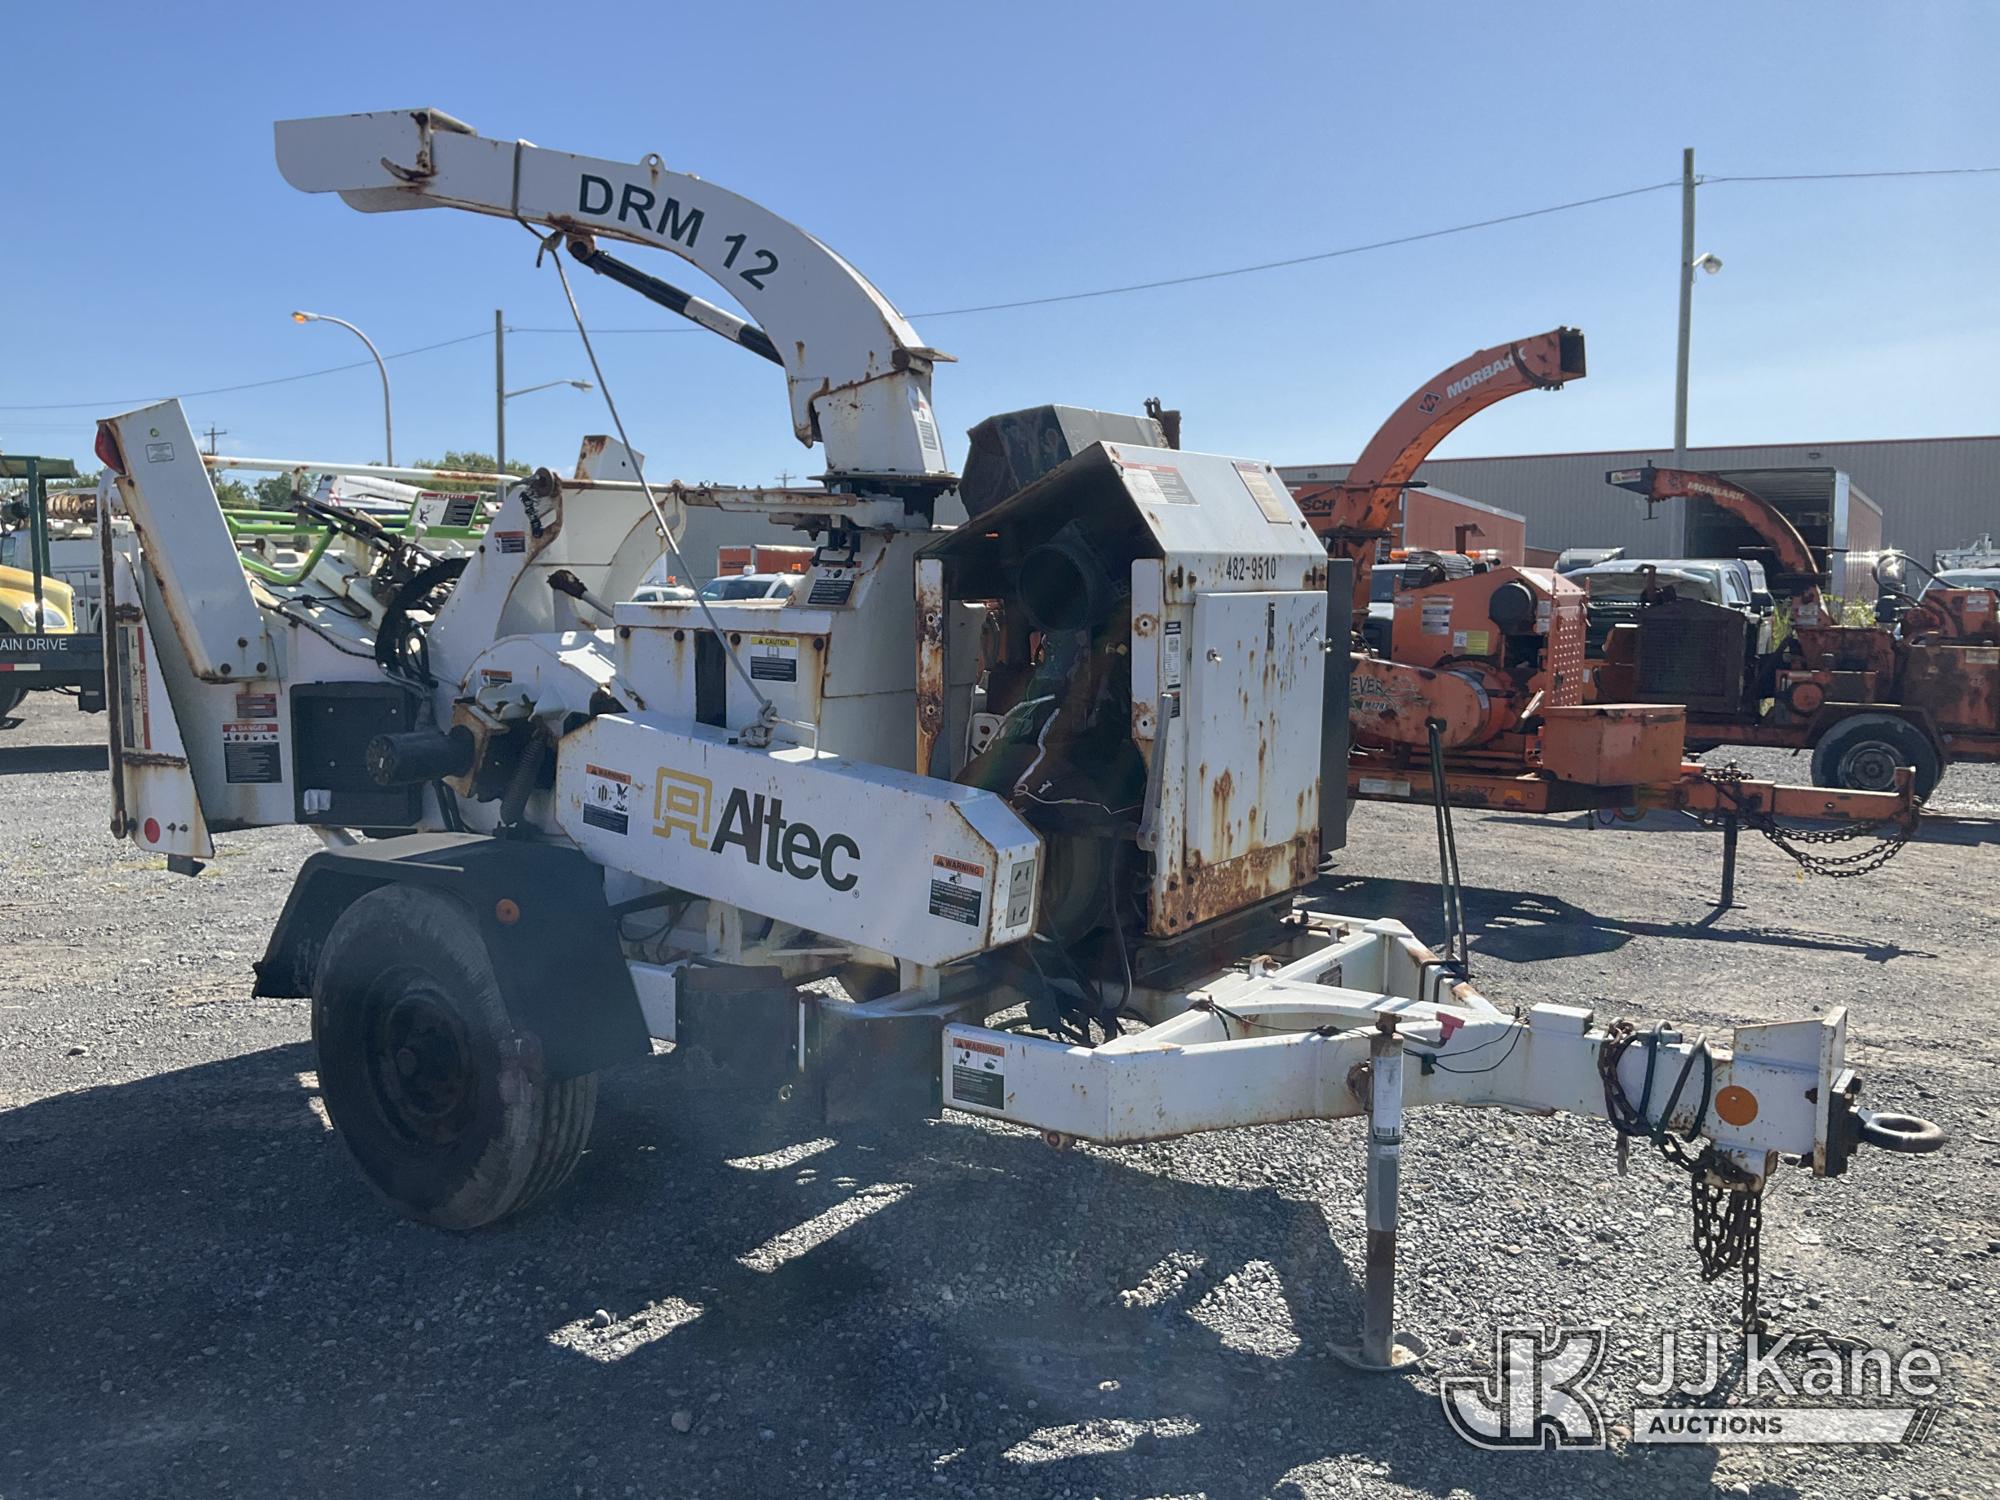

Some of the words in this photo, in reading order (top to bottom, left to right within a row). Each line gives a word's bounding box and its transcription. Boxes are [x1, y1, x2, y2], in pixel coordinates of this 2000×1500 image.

[578, 173, 705, 249] DRM
[723, 233, 779, 291] 12
[1446, 347, 1528, 398] MORBARK
[1687, 481, 1746, 501] MORBARK
[1226, 556, 1277, 581] 482-9510
[26, 637, 68, 651] DRIVE
[765, 637, 790, 647] CAUTION
[238, 724, 268, 732] DANGER
[710, 787, 861, 892] Altec
[945, 859, 980, 875] WARNING
[965, 1039, 1001, 1056] WARNING
